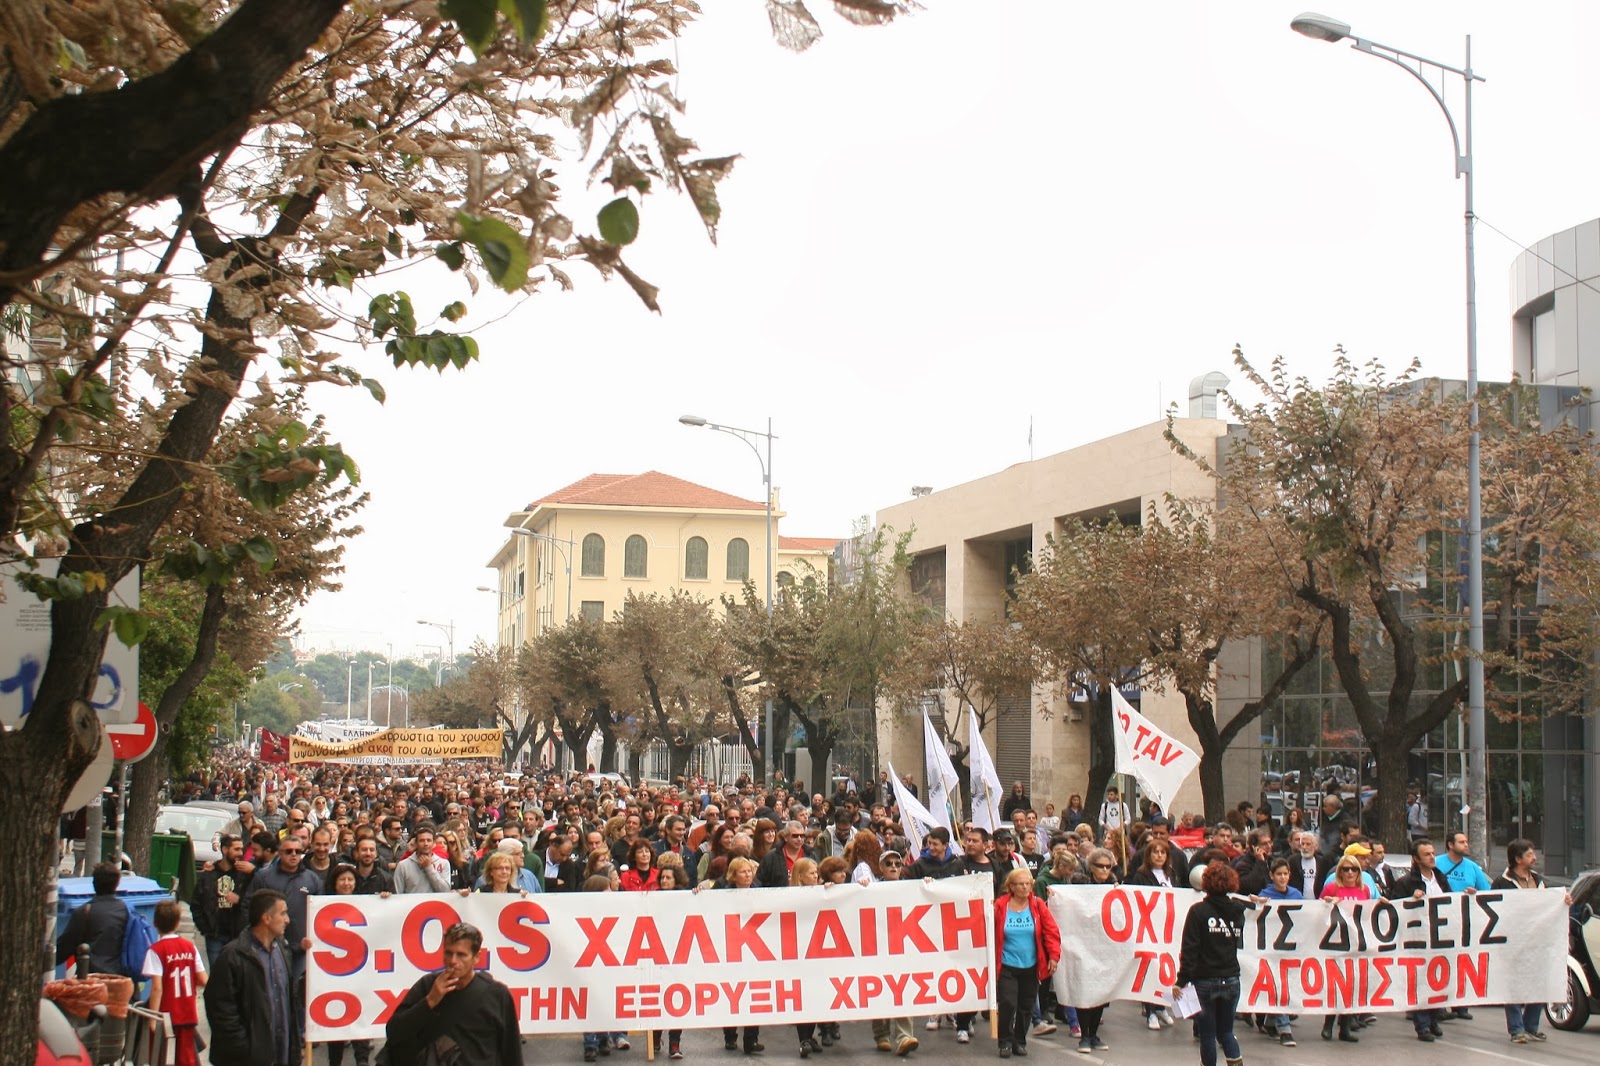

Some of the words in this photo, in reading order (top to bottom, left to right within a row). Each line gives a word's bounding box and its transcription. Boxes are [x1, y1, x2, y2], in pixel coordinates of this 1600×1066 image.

[397, 746, 417, 755] του
[420, 744, 457, 757] αγώνα
[438, 732, 456, 743] του
[460, 731, 500, 744] χρυσού
[1133, 725, 1184, 767] TAV
[313, 900, 551, 977] S.O.S
[575, 898, 988, 968] ΧΑΛΚΙΔΙΚΗ
[1101, 888, 1176, 945] ΟΧΙ
[1317, 894, 1508, 953] ΔΙΩΞΕΙΣ
[169, 965, 193, 999] 11
[309, 988, 411, 1028] ΟΧ
[615, 979, 803, 1019] ΕΞΟΡΥΞΗ
[830, 966, 990, 1010] ΧΡΥΣΟΥ
[1131, 950, 1184, 998] ΤΩ
[1247, 952, 1490, 1009] ΑΓΩΝΙΣΤΩΝ
